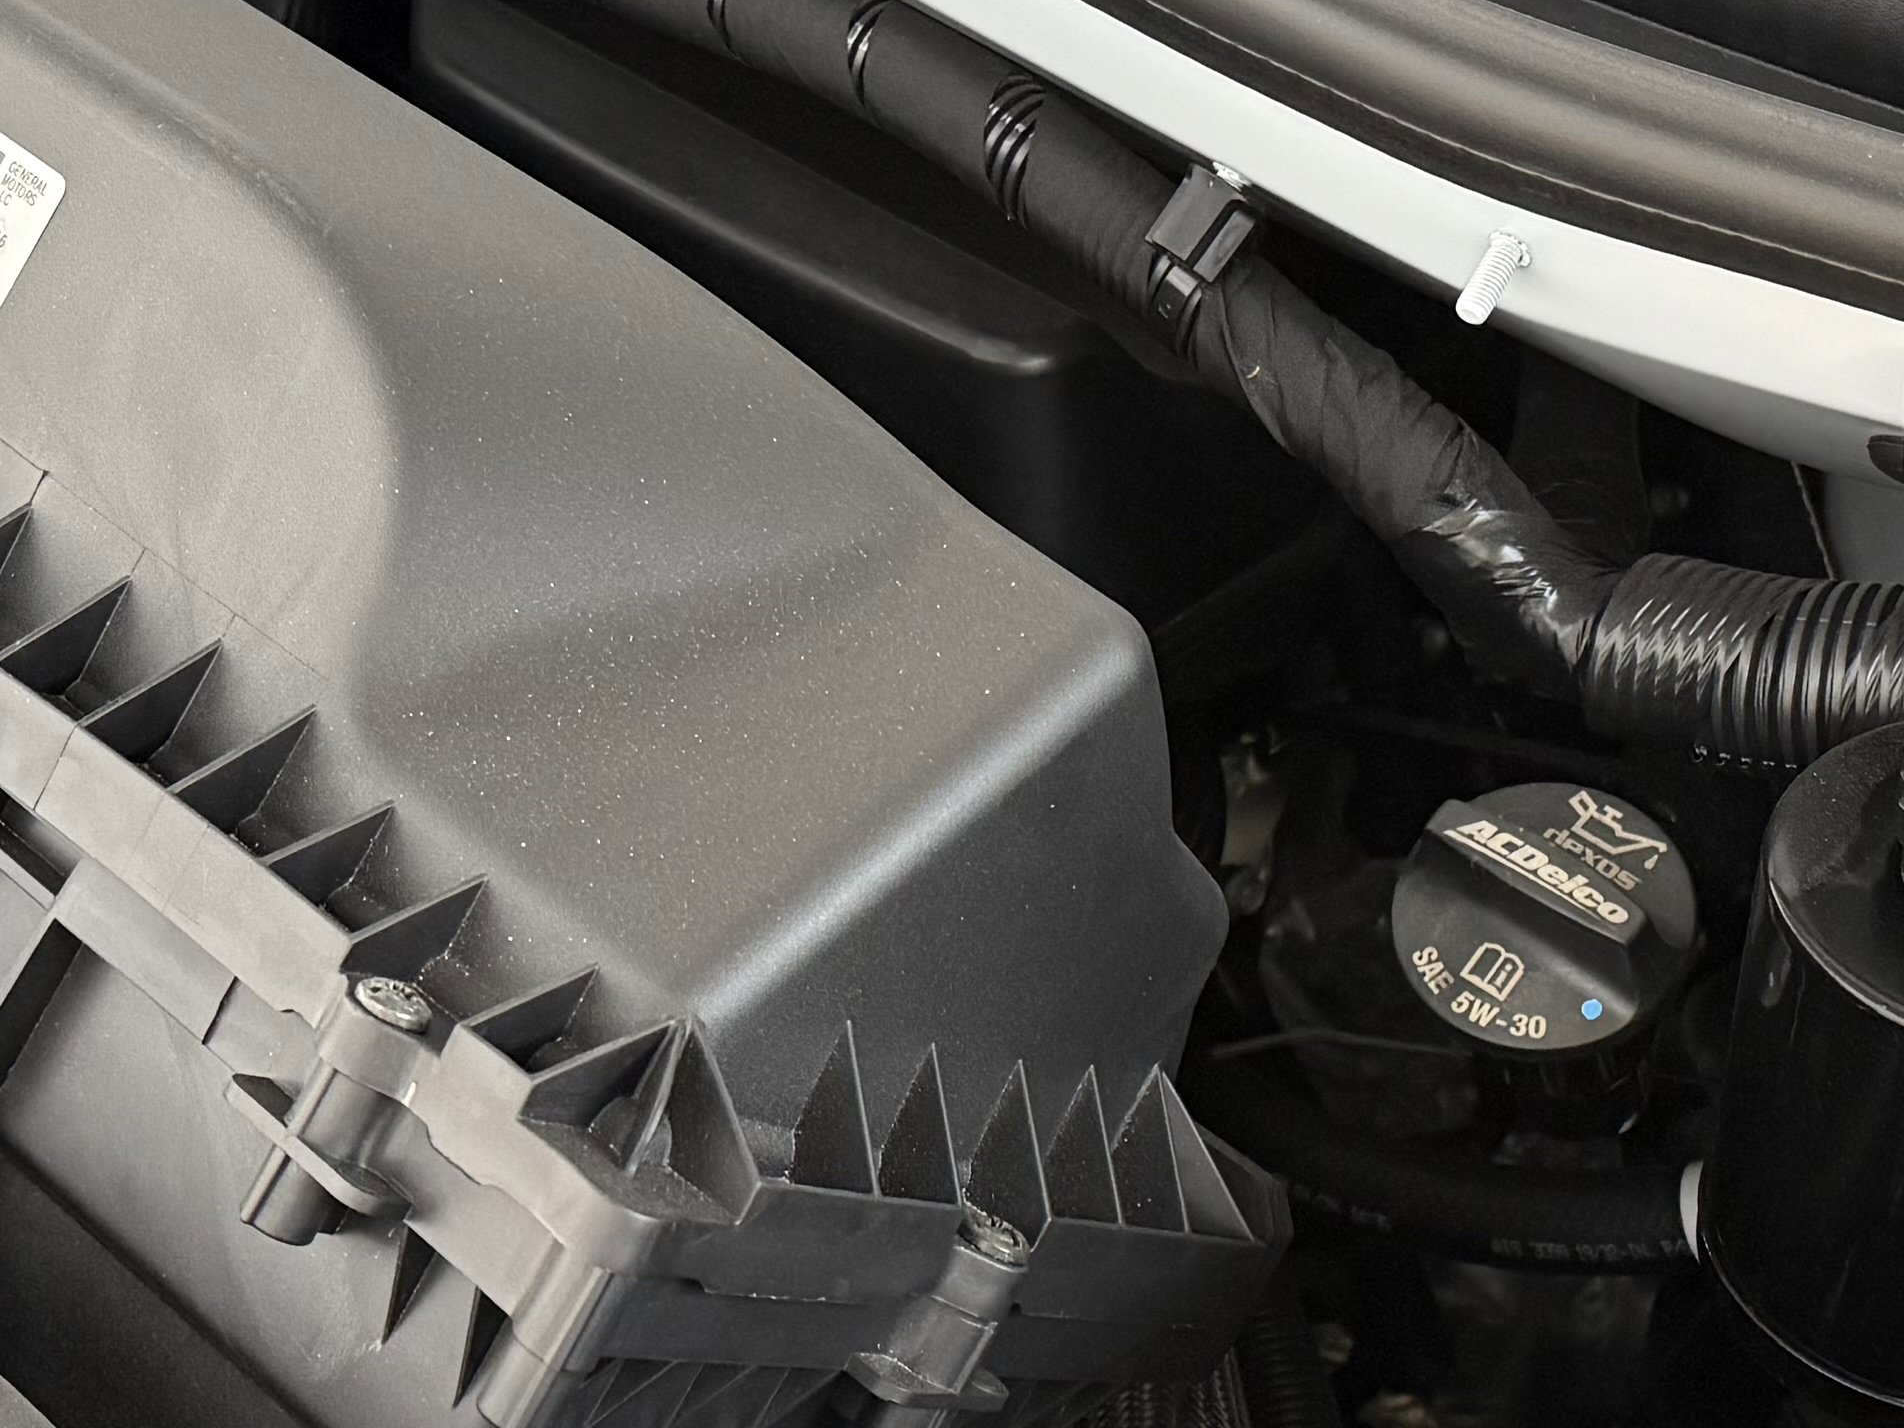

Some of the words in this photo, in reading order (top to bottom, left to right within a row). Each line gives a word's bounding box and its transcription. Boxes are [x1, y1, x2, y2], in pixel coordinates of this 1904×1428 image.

[0, 173, 39, 208] MOTORS
[6, 159, 50, 197] GENERAL
[1454, 820, 1629, 924] ACDelco
[1543, 827, 1643, 891] dexos
[1412, 945, 1455, 995] SAE
[1450, 990, 1547, 1040] 5W-30
